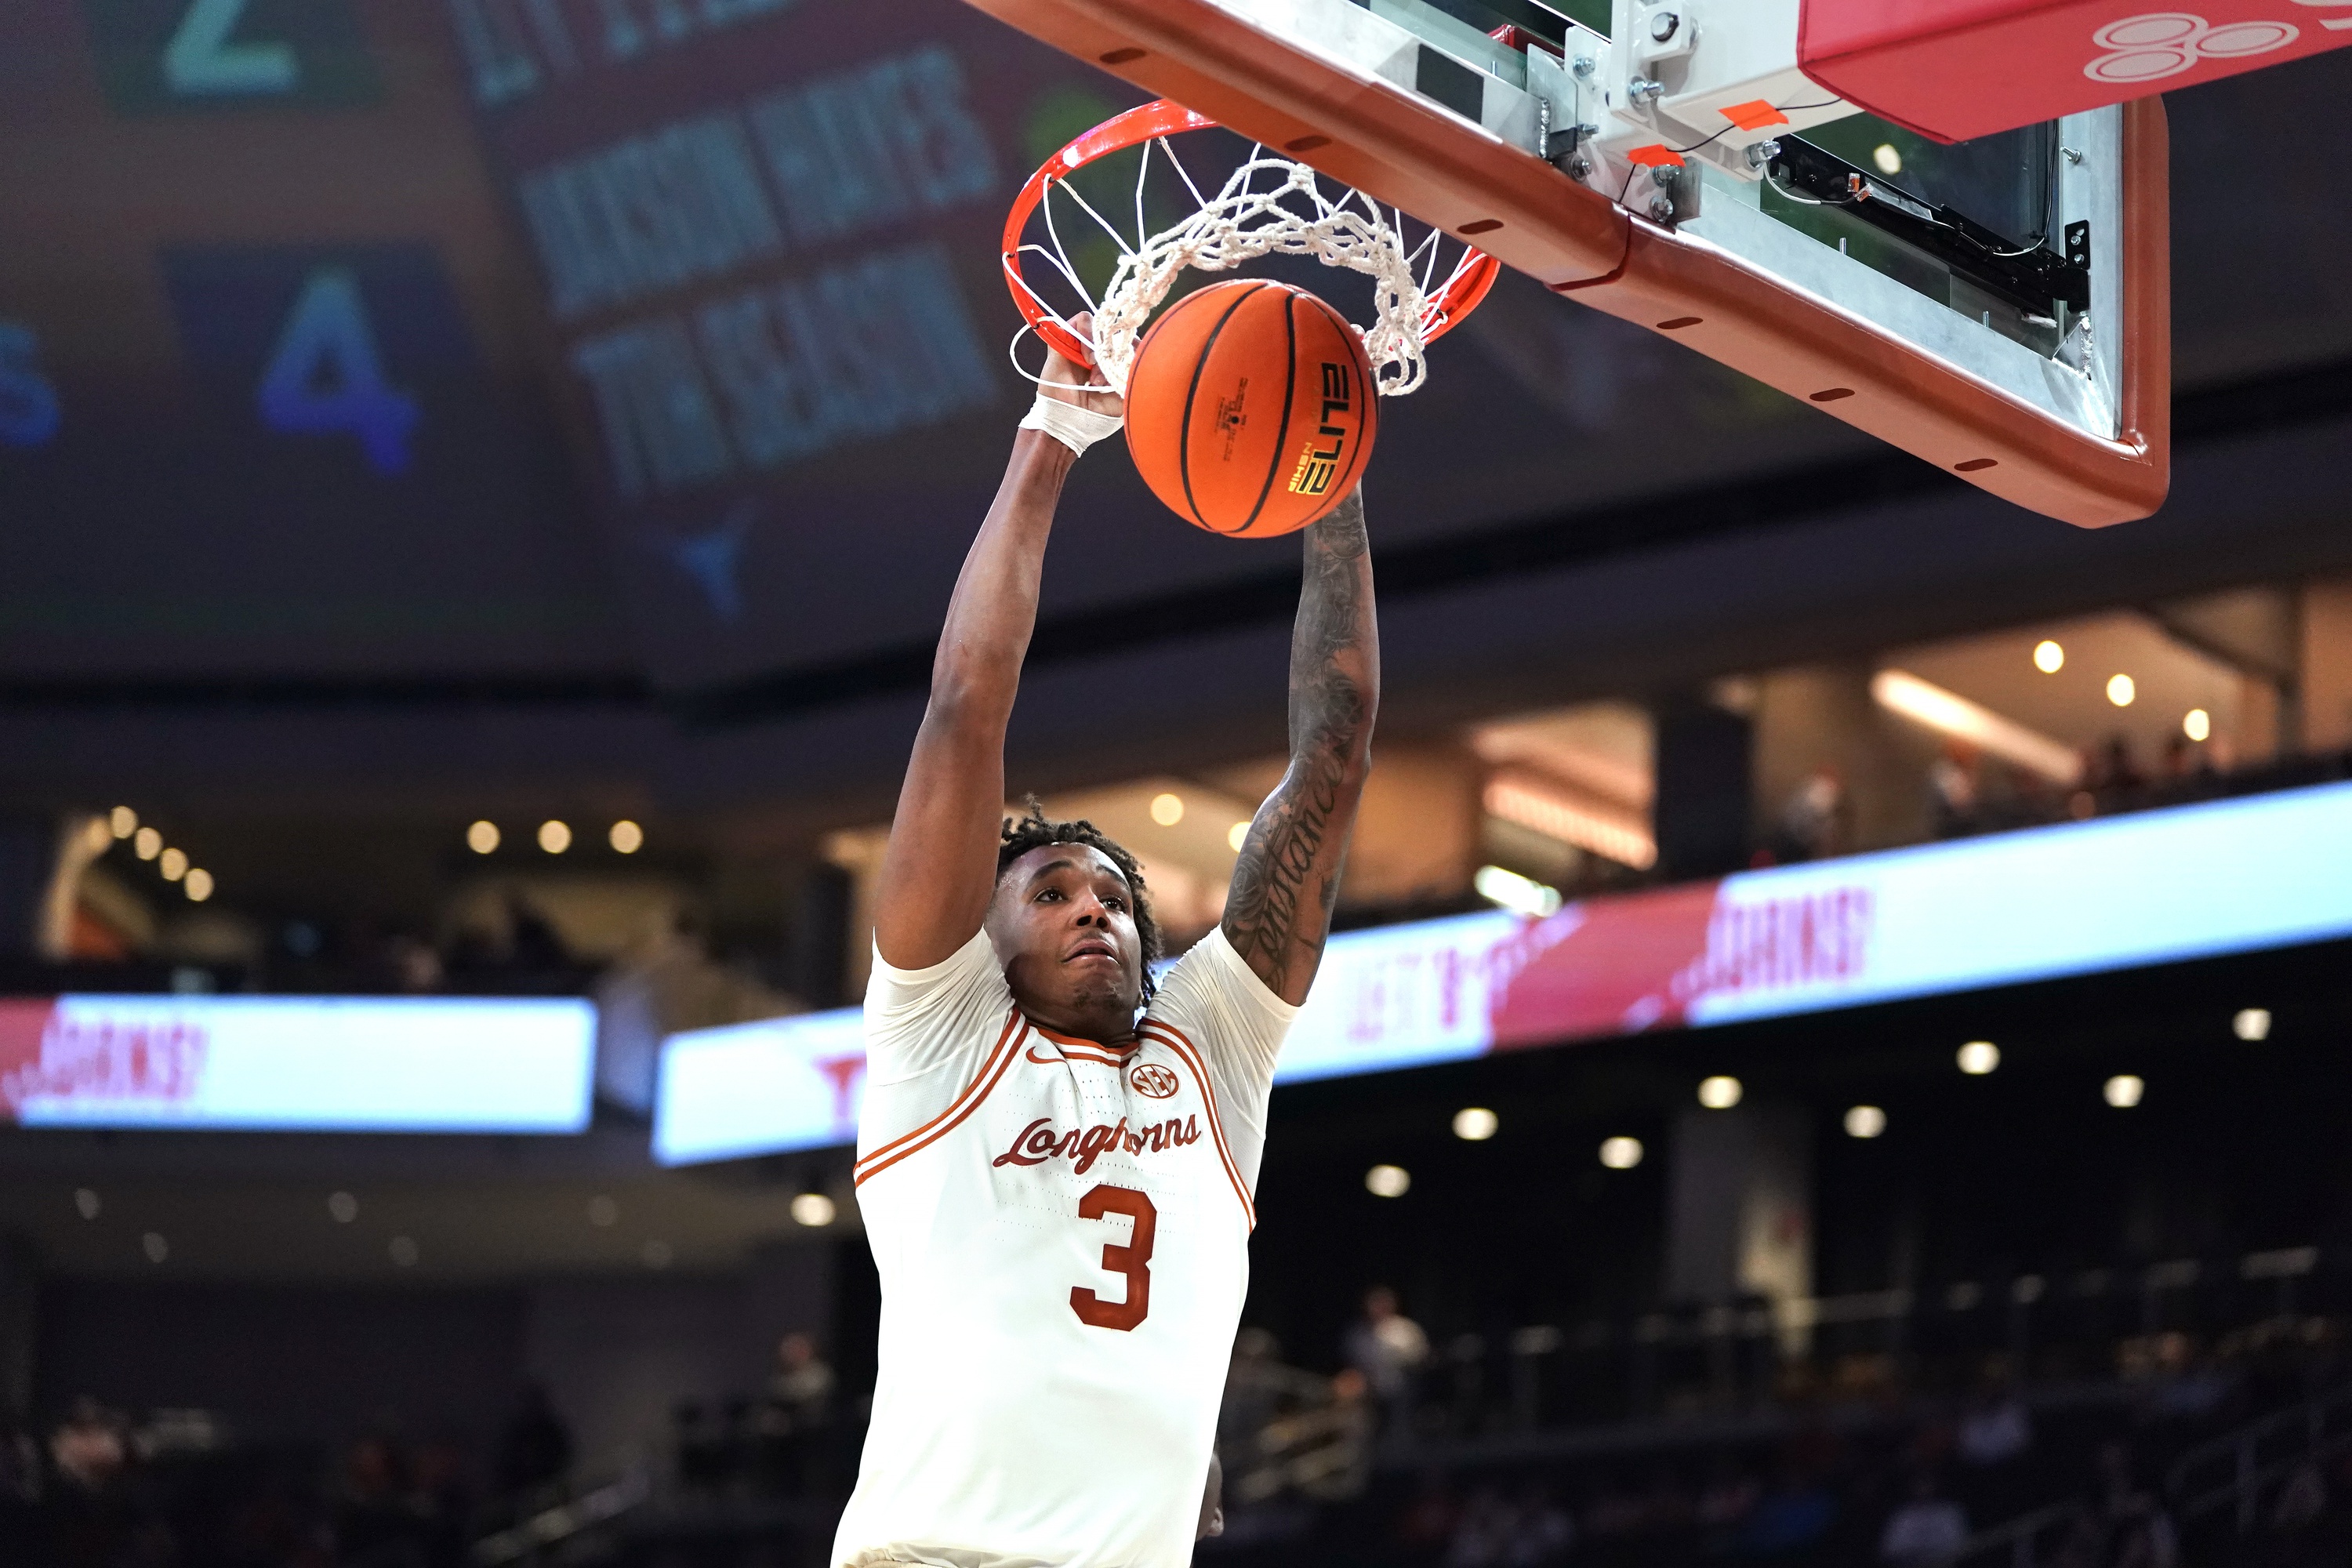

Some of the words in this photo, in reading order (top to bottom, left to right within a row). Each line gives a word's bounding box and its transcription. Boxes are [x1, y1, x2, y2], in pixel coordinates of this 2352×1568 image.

[260, 265, 420, 475] 4
[1295, 361, 1349, 495] ELITE
[992, 1113, 1202, 1175] Longhorns
[1133, 1064, 1177, 1097] SEC
[1069, 1184, 1158, 1332] 3
